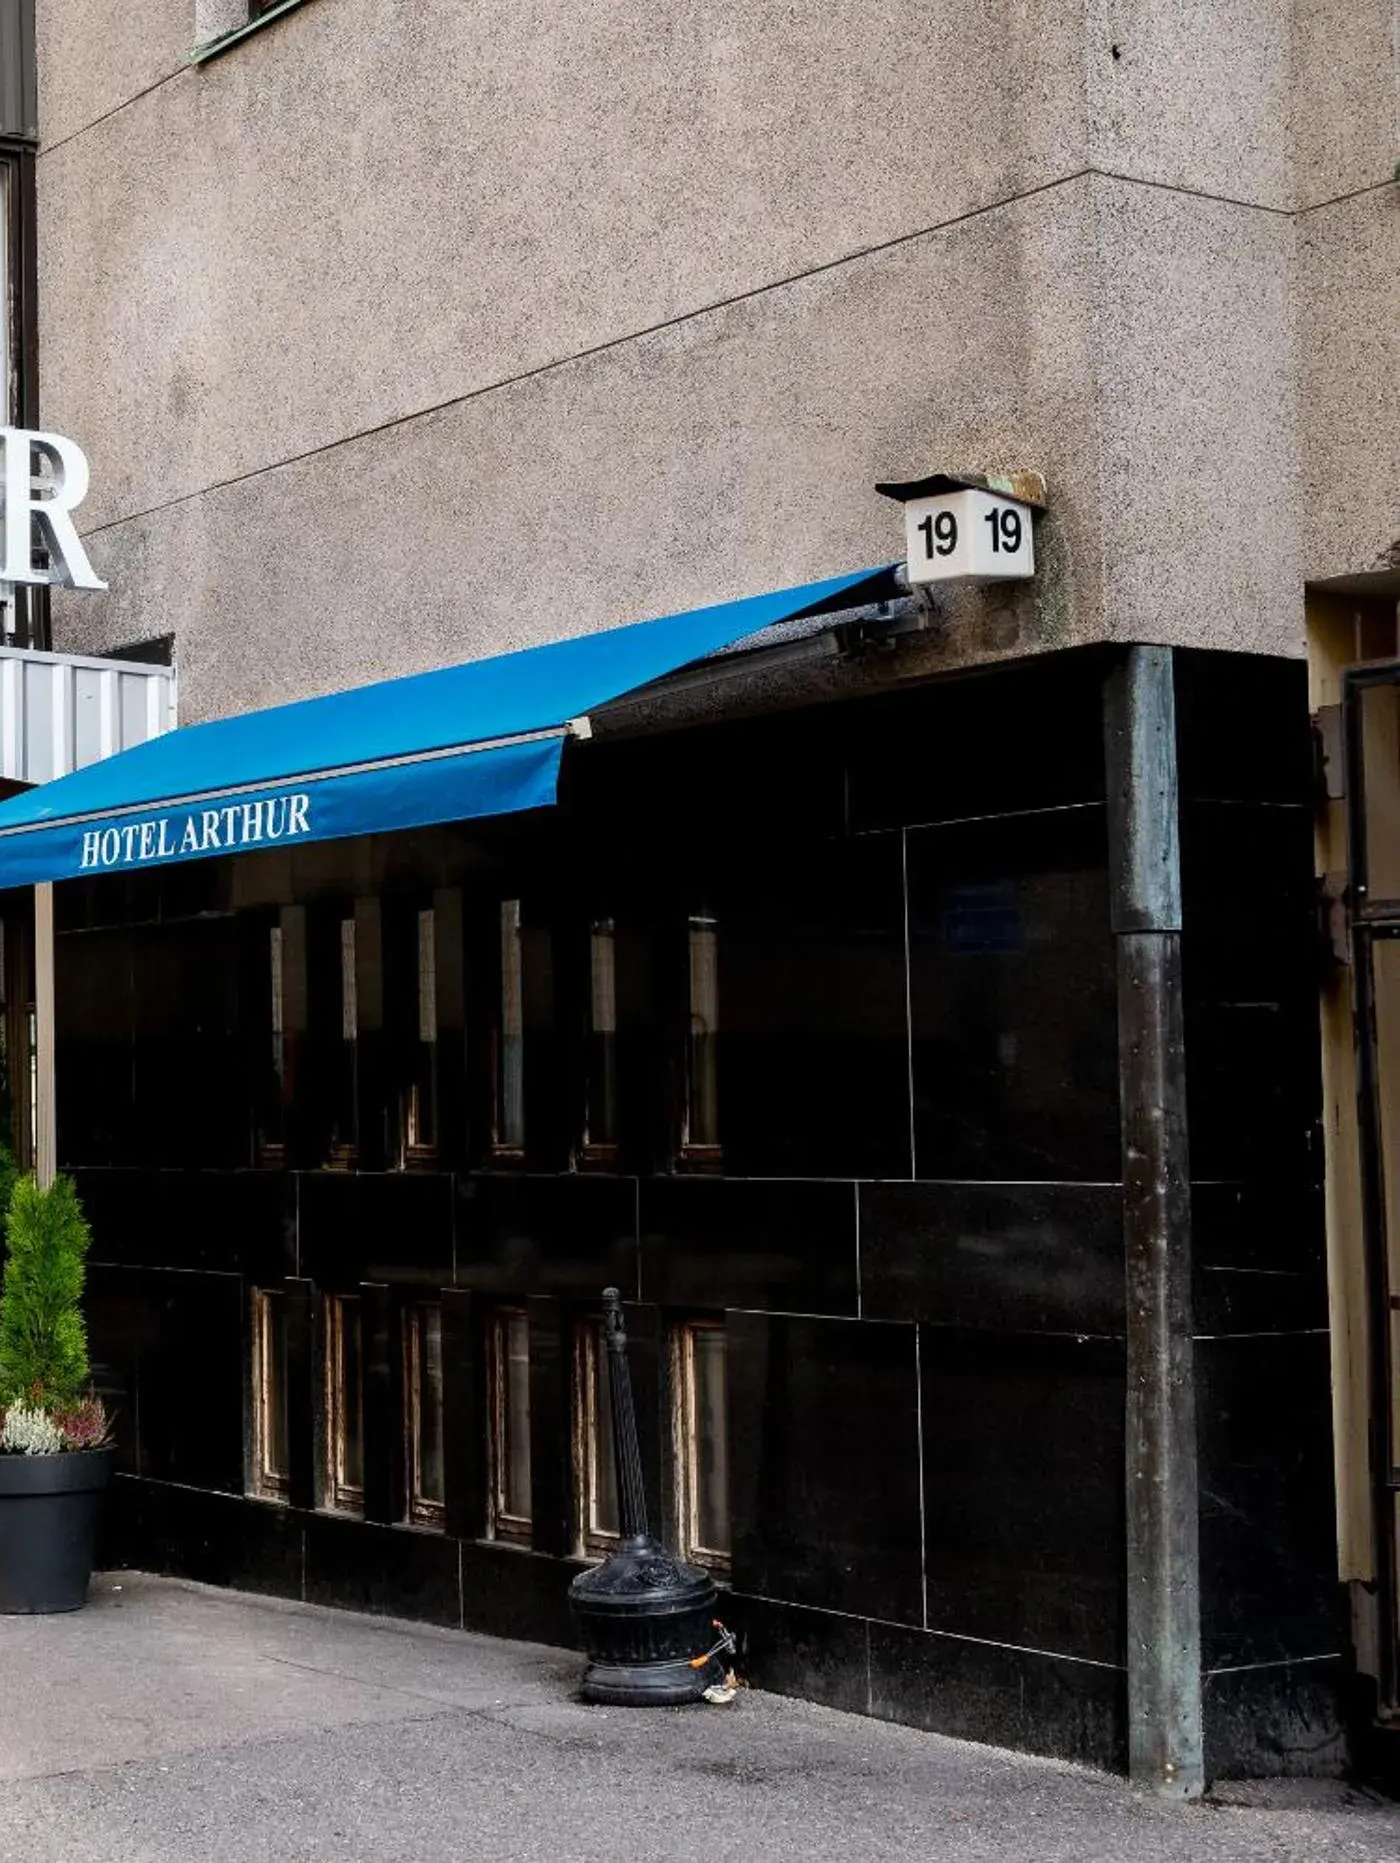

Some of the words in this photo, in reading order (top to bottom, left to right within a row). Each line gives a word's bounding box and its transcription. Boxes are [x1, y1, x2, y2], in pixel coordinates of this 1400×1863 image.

[917, 511, 958, 560] 19
[984, 507, 1022, 553] 19
[79, 818, 176, 869] HOTEL
[179, 794, 311, 854] ARTHUR
